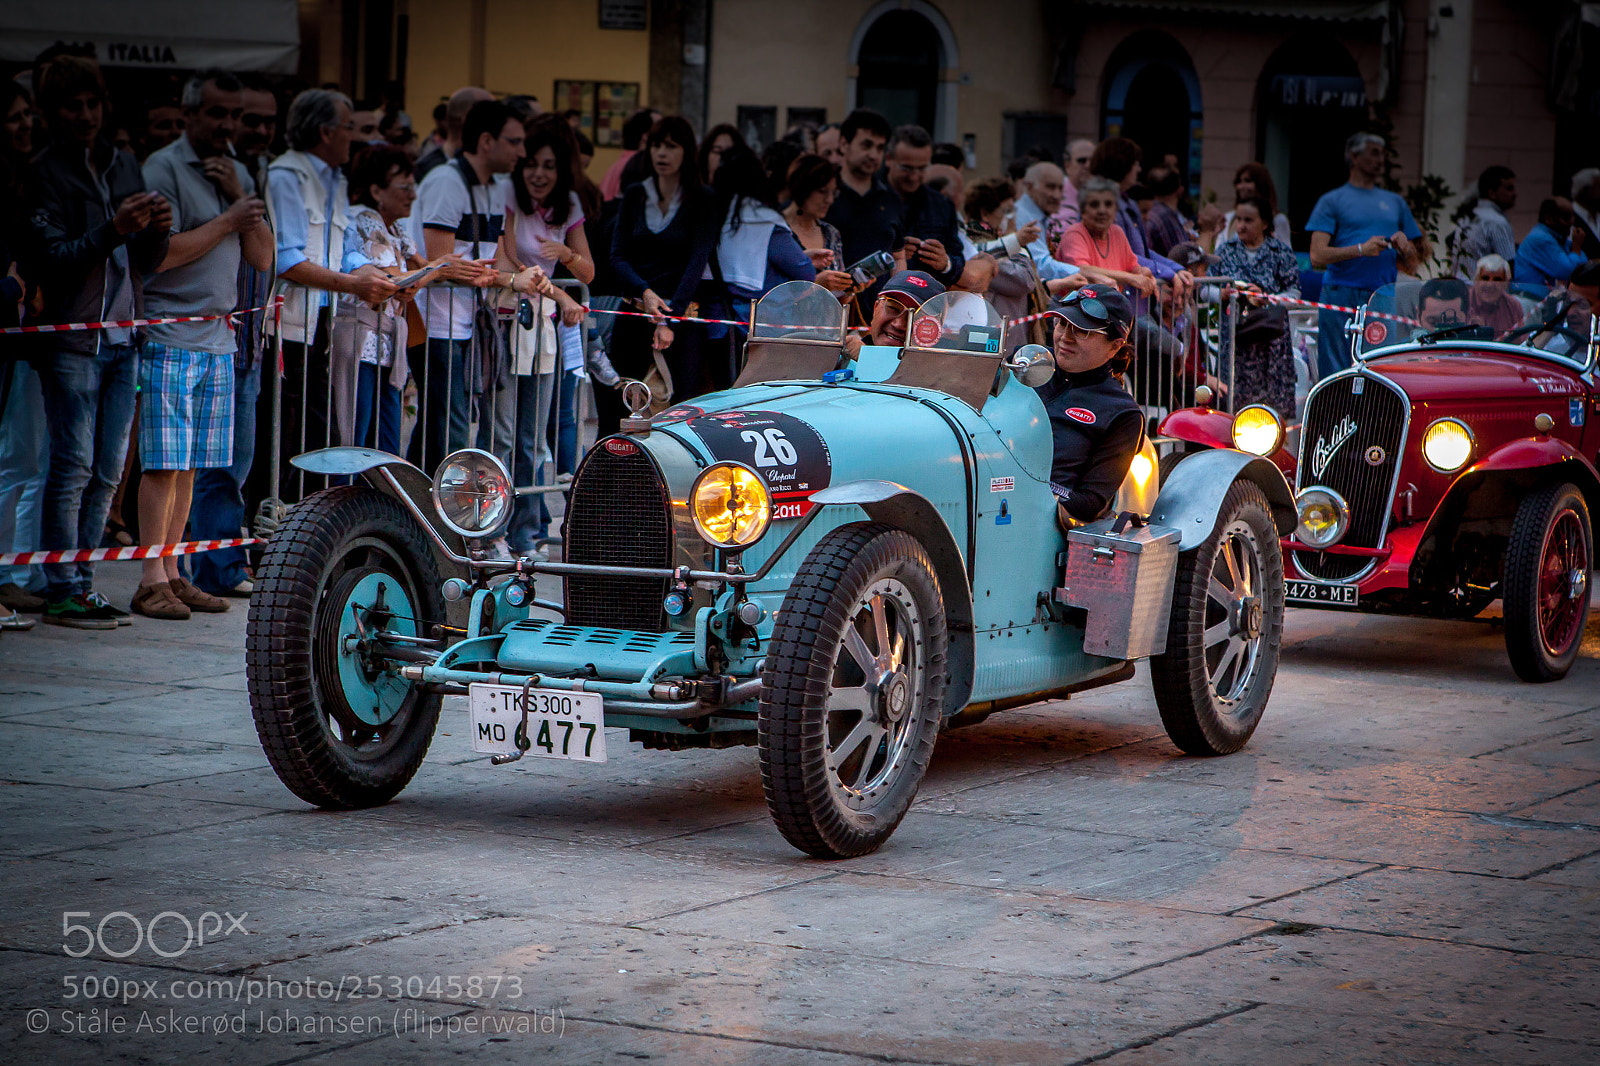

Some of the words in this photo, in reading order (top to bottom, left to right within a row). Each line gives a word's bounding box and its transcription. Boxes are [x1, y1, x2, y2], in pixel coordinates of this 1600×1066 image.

[109, 44, 176, 63] ITALIA
[987, 344, 997, 352] 10
[1067, 409, 1093, 422] BUGATTI
[740, 428, 798, 468] 26
[1312, 414, 1358, 480] Balilla
[765, 468, 797, 483] Chopard
[772, 503, 801, 519] 2011
[1330, 586, 1354, 602] ME
[500, 691, 572, 715] TKS300
[478, 722, 505, 741] MO
[514, 719, 596, 757] 6477
